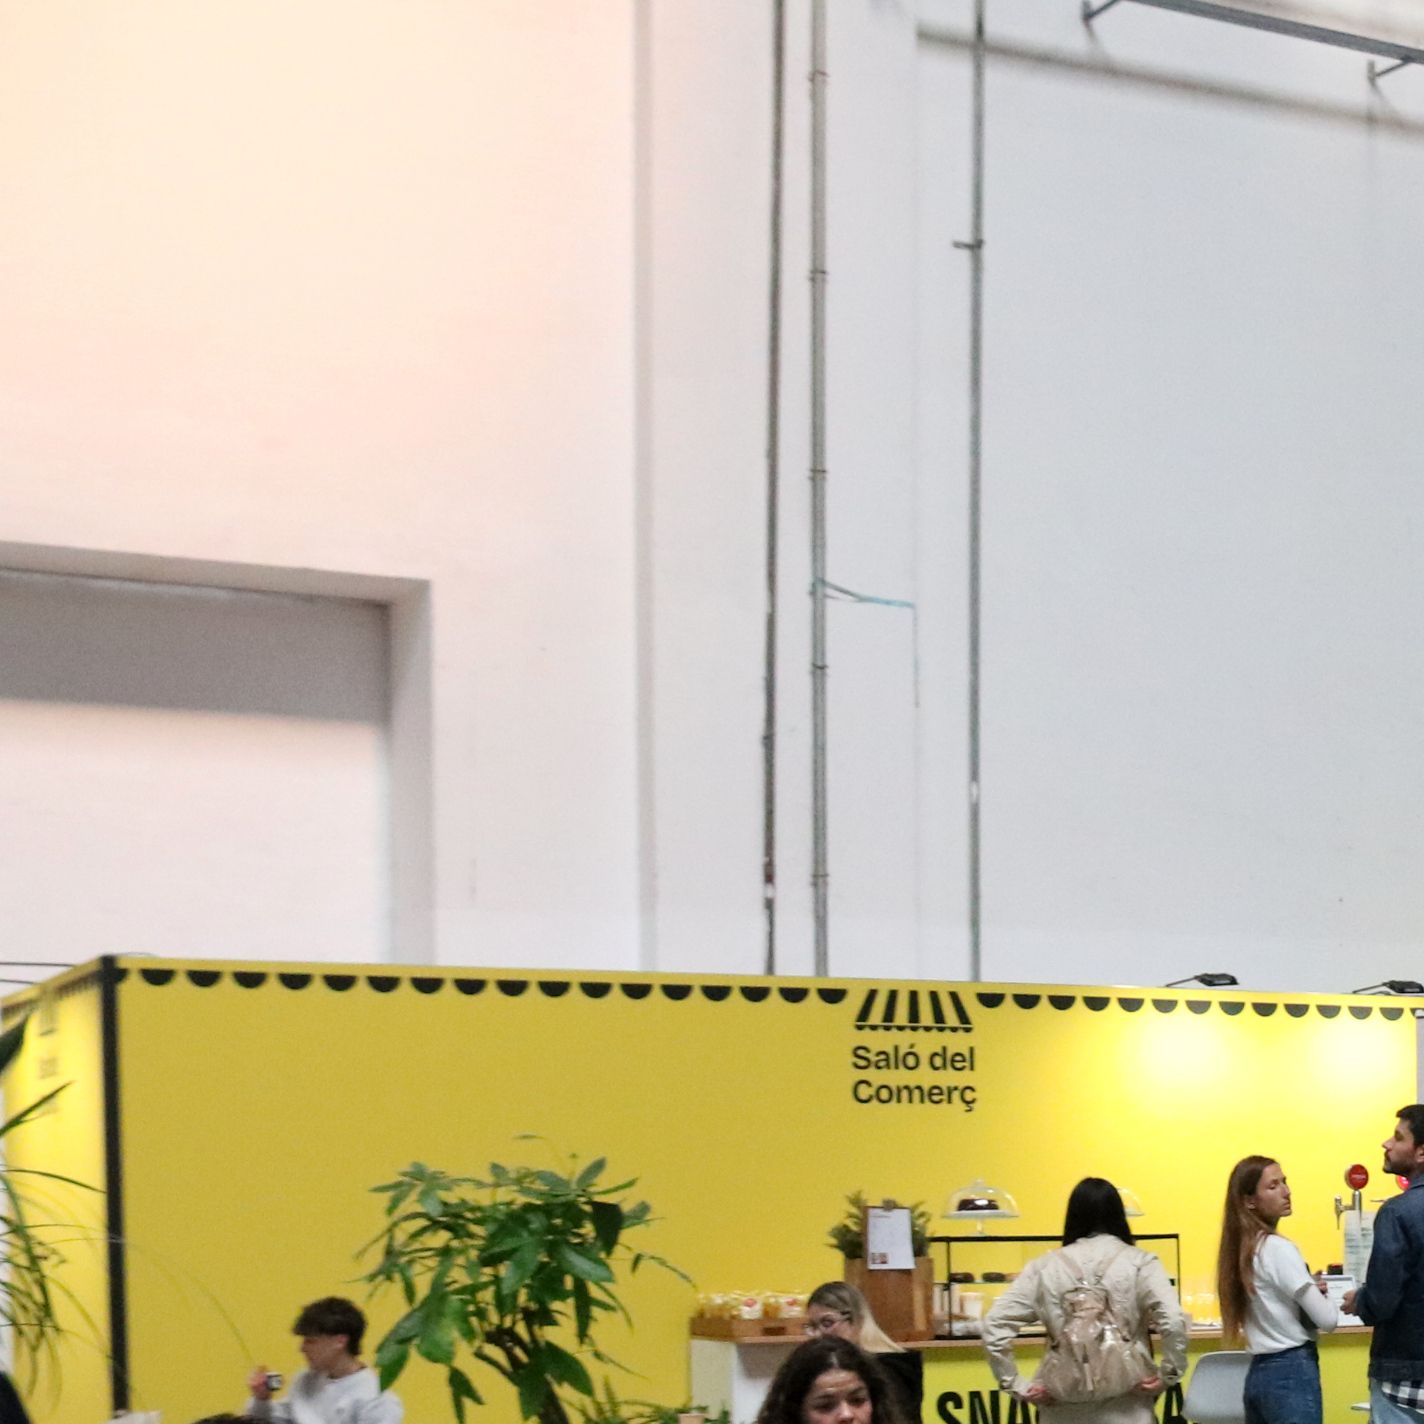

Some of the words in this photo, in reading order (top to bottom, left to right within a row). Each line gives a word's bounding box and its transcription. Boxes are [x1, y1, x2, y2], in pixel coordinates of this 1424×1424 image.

[852, 1043, 920, 1071] Saló
[929, 1045, 975, 1072] del
[853, 1079, 977, 1113] Comerç
